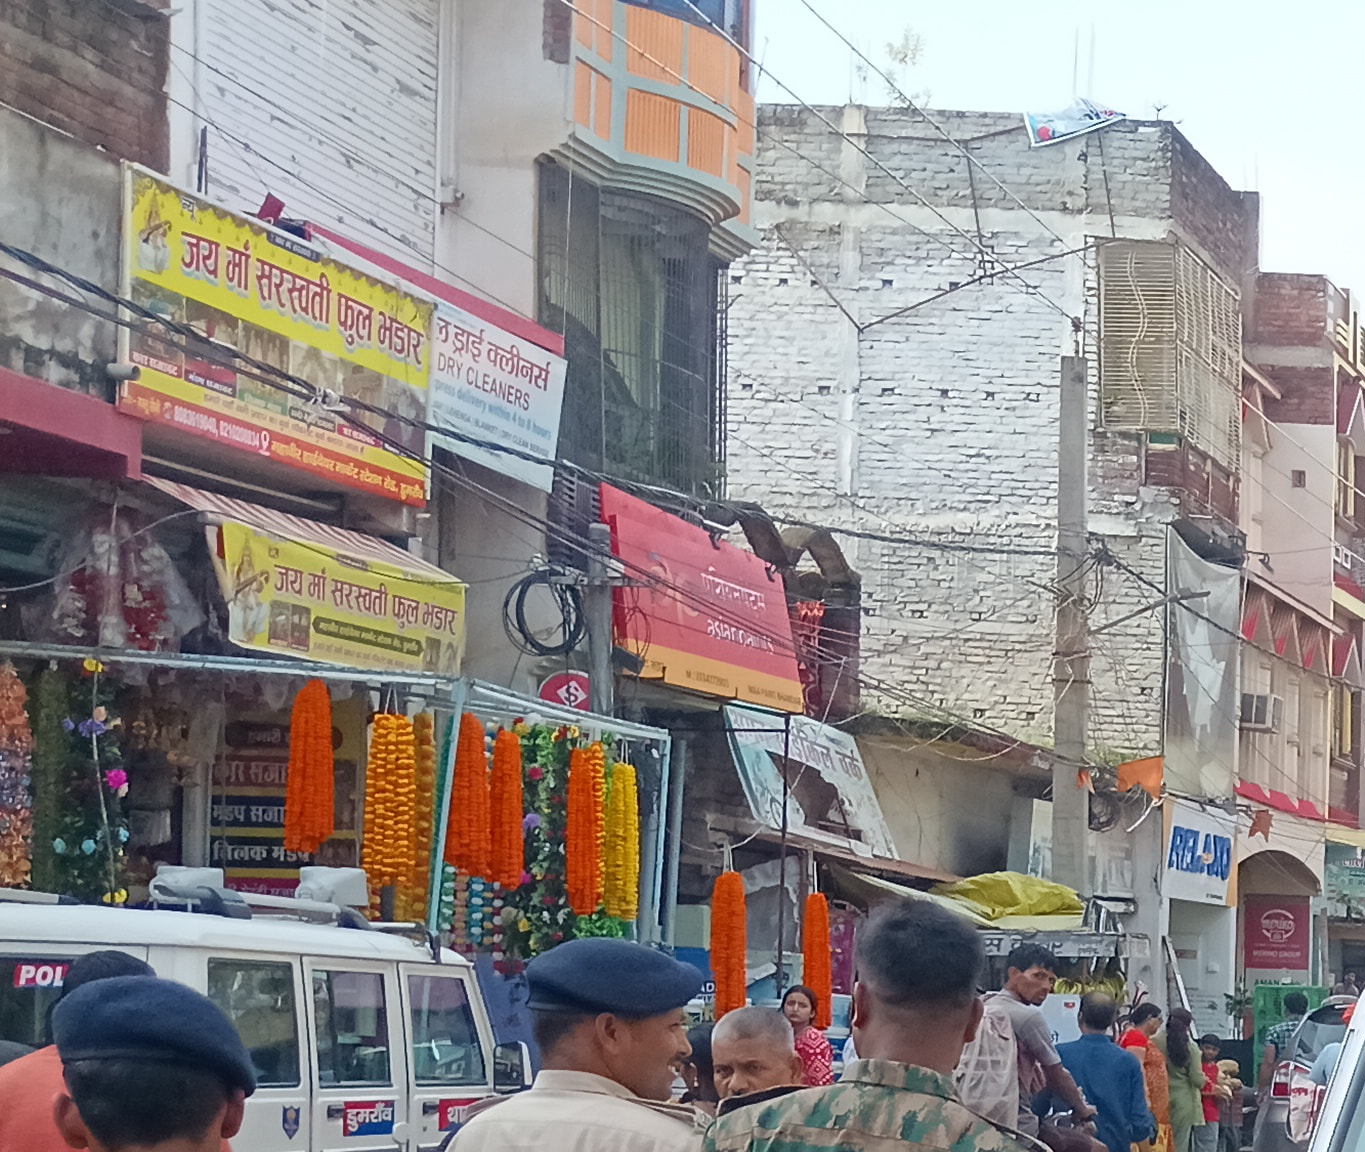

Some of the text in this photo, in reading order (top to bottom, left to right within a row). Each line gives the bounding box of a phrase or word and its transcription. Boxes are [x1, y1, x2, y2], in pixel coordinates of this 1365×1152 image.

[181, 231, 220, 279] जय
[226, 239, 251, 291] मां
[256, 258, 332, 325] सरस्वती
[453, 324, 486, 364] ड्राई
[487, 341, 552, 392] क्लीनर्स
[434, 378, 456, 398] press
[437, 352, 530, 412] DRY CLEANERS
[274, 564, 303, 596] जय
[331, 577, 388, 617] सरस्वती
[250, 761, 288, 784] सजा
[250, 804, 285, 824] सजा
[18, 965, 65, 988] POL
[346, 1102, 468, 1132] डुमराँव था
